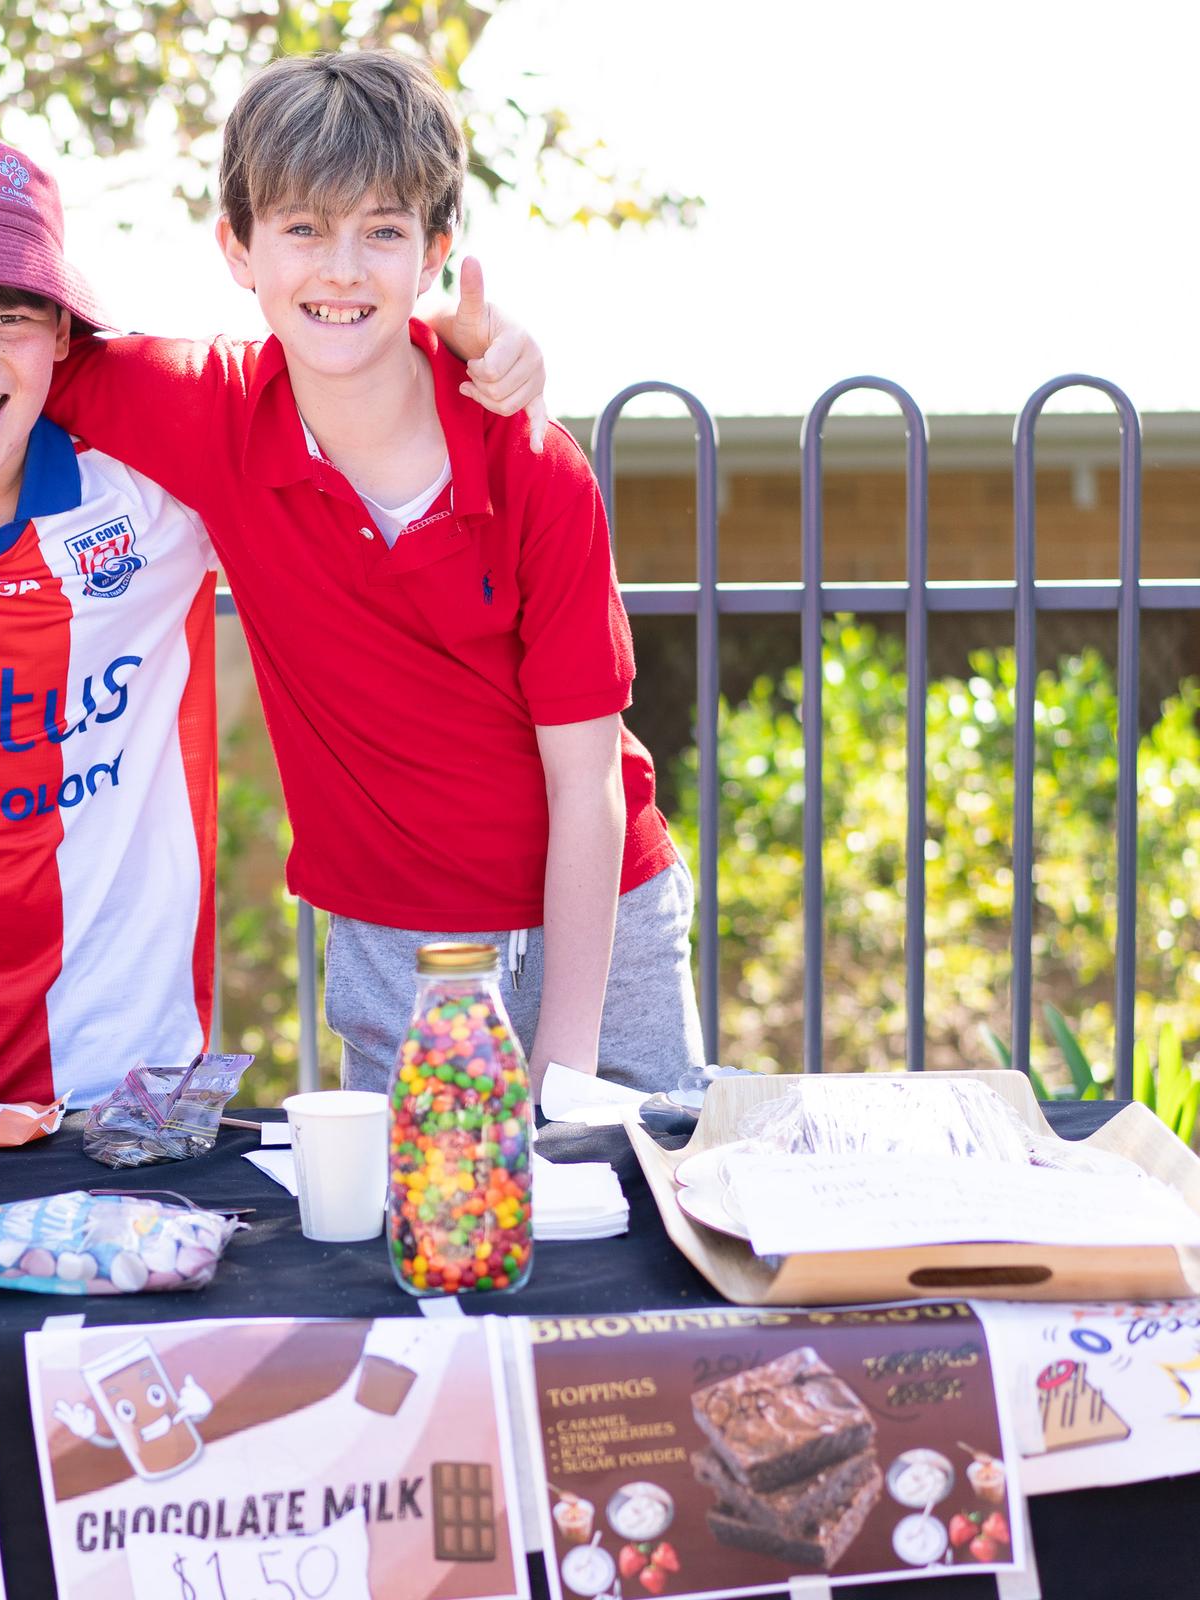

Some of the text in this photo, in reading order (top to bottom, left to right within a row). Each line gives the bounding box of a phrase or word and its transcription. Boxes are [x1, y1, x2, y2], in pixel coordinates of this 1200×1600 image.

[71, 521, 127, 553] THE COVE
[546, 1377, 657, 1408] TOPPINGS
[556, 1414, 628, 1434] CARAMEL
[558, 1422, 676, 1445] STRAWBERRIES
[561, 1444, 605, 1460] ICING
[562, 1447, 687, 1474] SUGAR POWDER
[76, 1477, 424, 1552] CHOCOLATE MILK
[173, 1544, 339, 1600] $150
